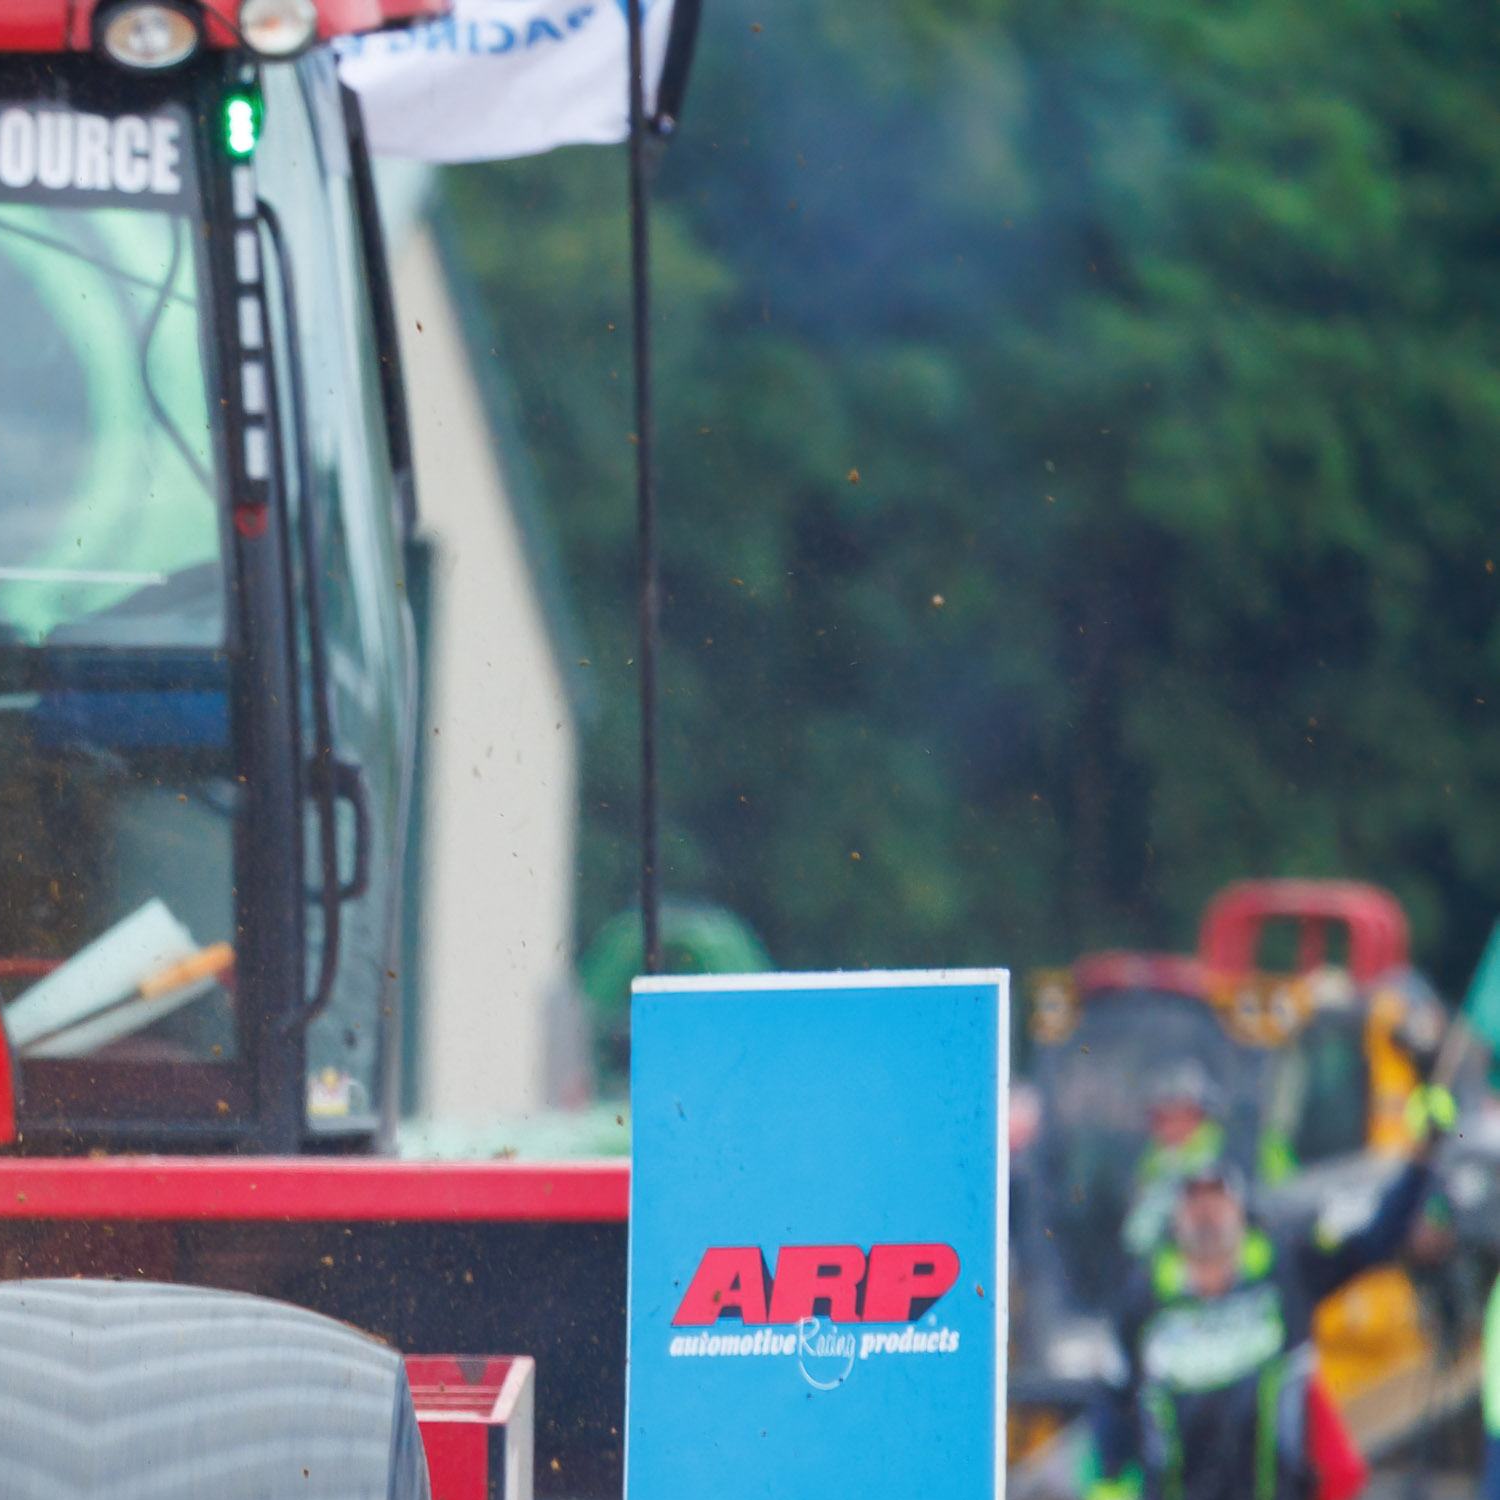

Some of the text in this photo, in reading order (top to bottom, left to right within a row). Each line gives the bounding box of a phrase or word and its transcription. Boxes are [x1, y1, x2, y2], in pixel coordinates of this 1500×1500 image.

[670, 1243, 961, 1327] ARP
[669, 1328, 797, 1358] automotive
[860, 1326, 960, 1360] products
